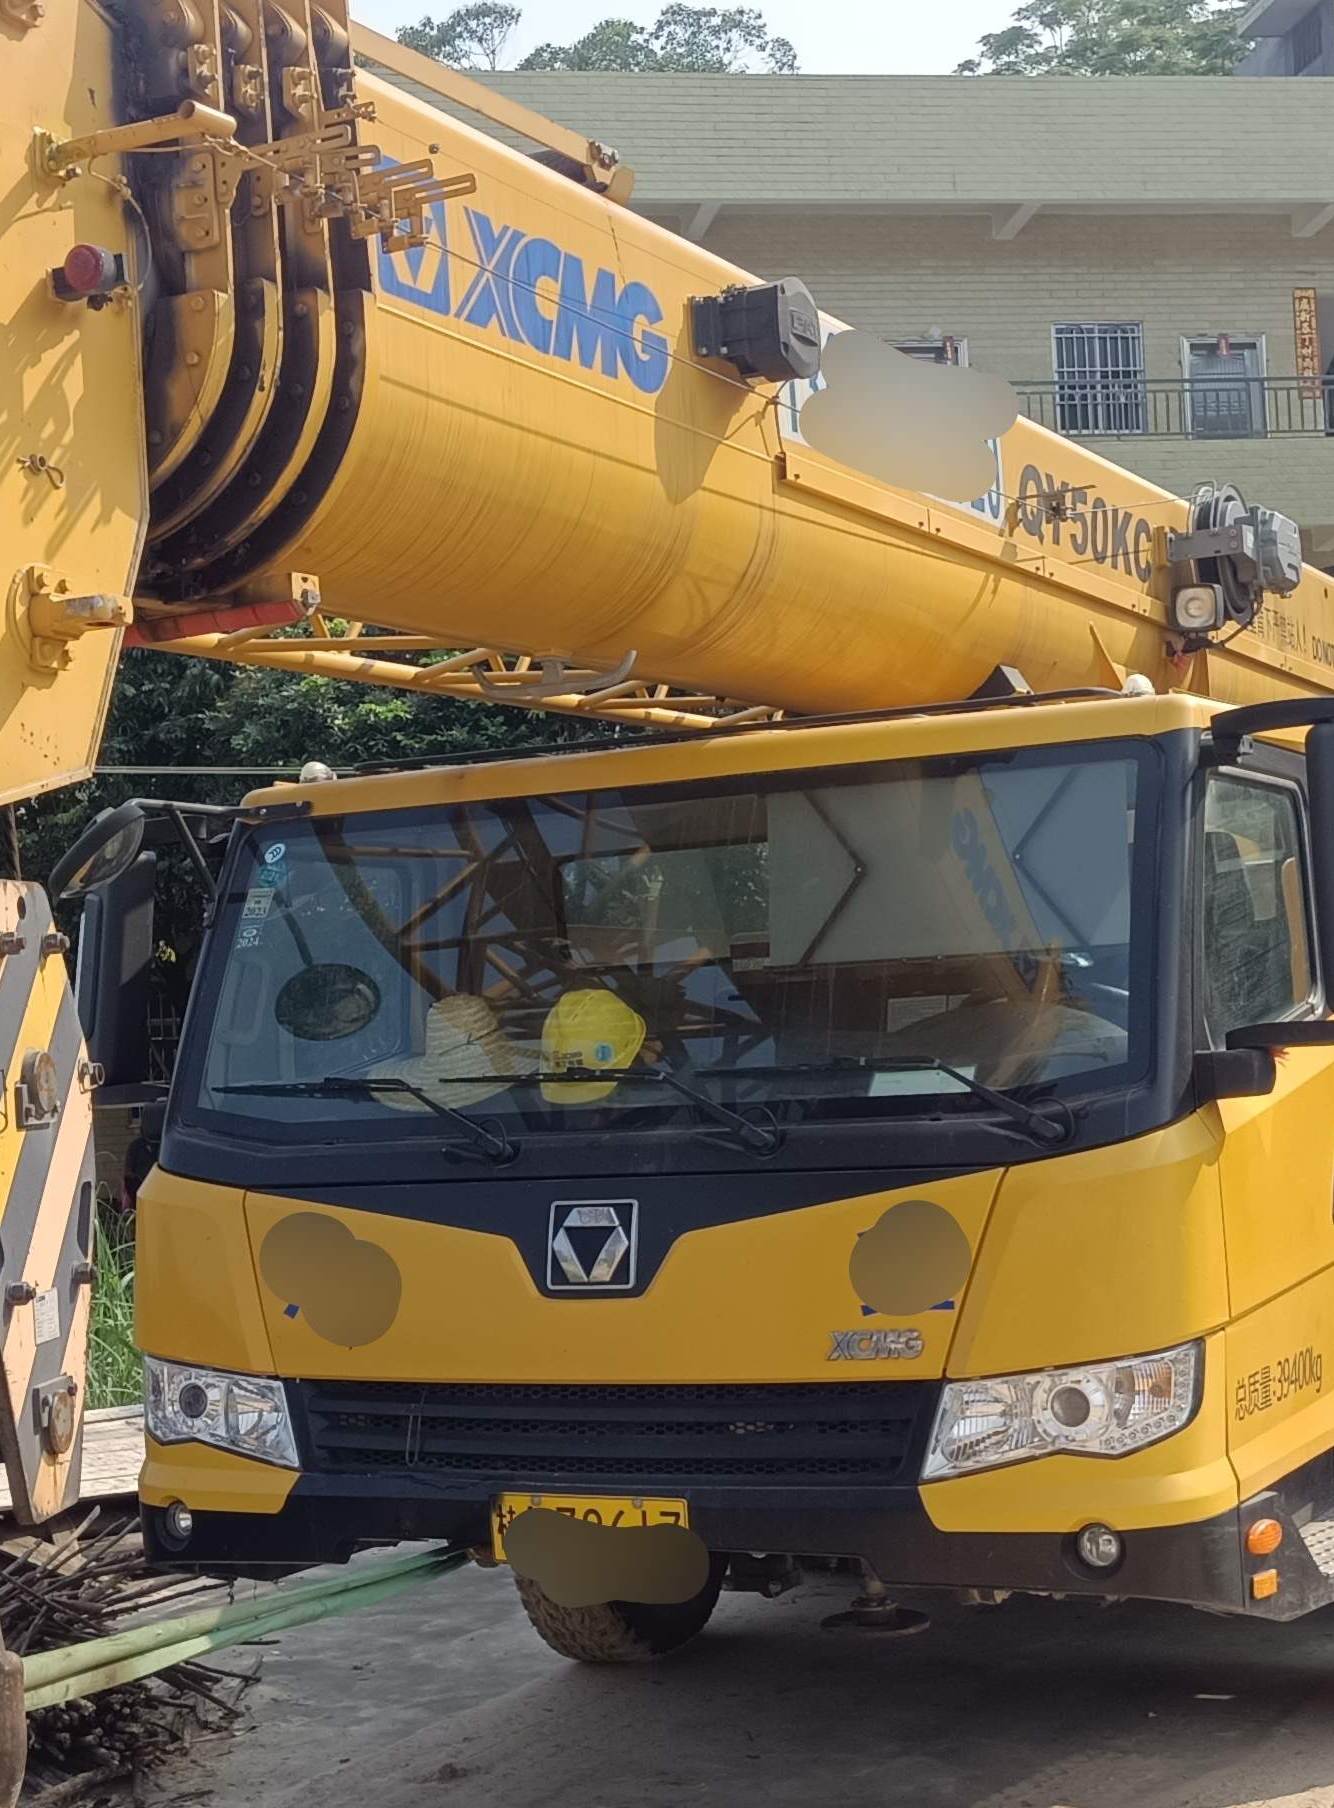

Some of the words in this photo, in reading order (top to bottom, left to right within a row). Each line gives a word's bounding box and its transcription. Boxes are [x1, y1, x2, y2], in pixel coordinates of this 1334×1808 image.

[454, 206, 668, 394] XCMG
[1312, 636, 1323, 661] DO
[1323, 641, 1334, 668] NOT
[827, 1329, 924, 1361] XCMG
[1235, 1346, 1322, 1421] 总质量:39400kg
